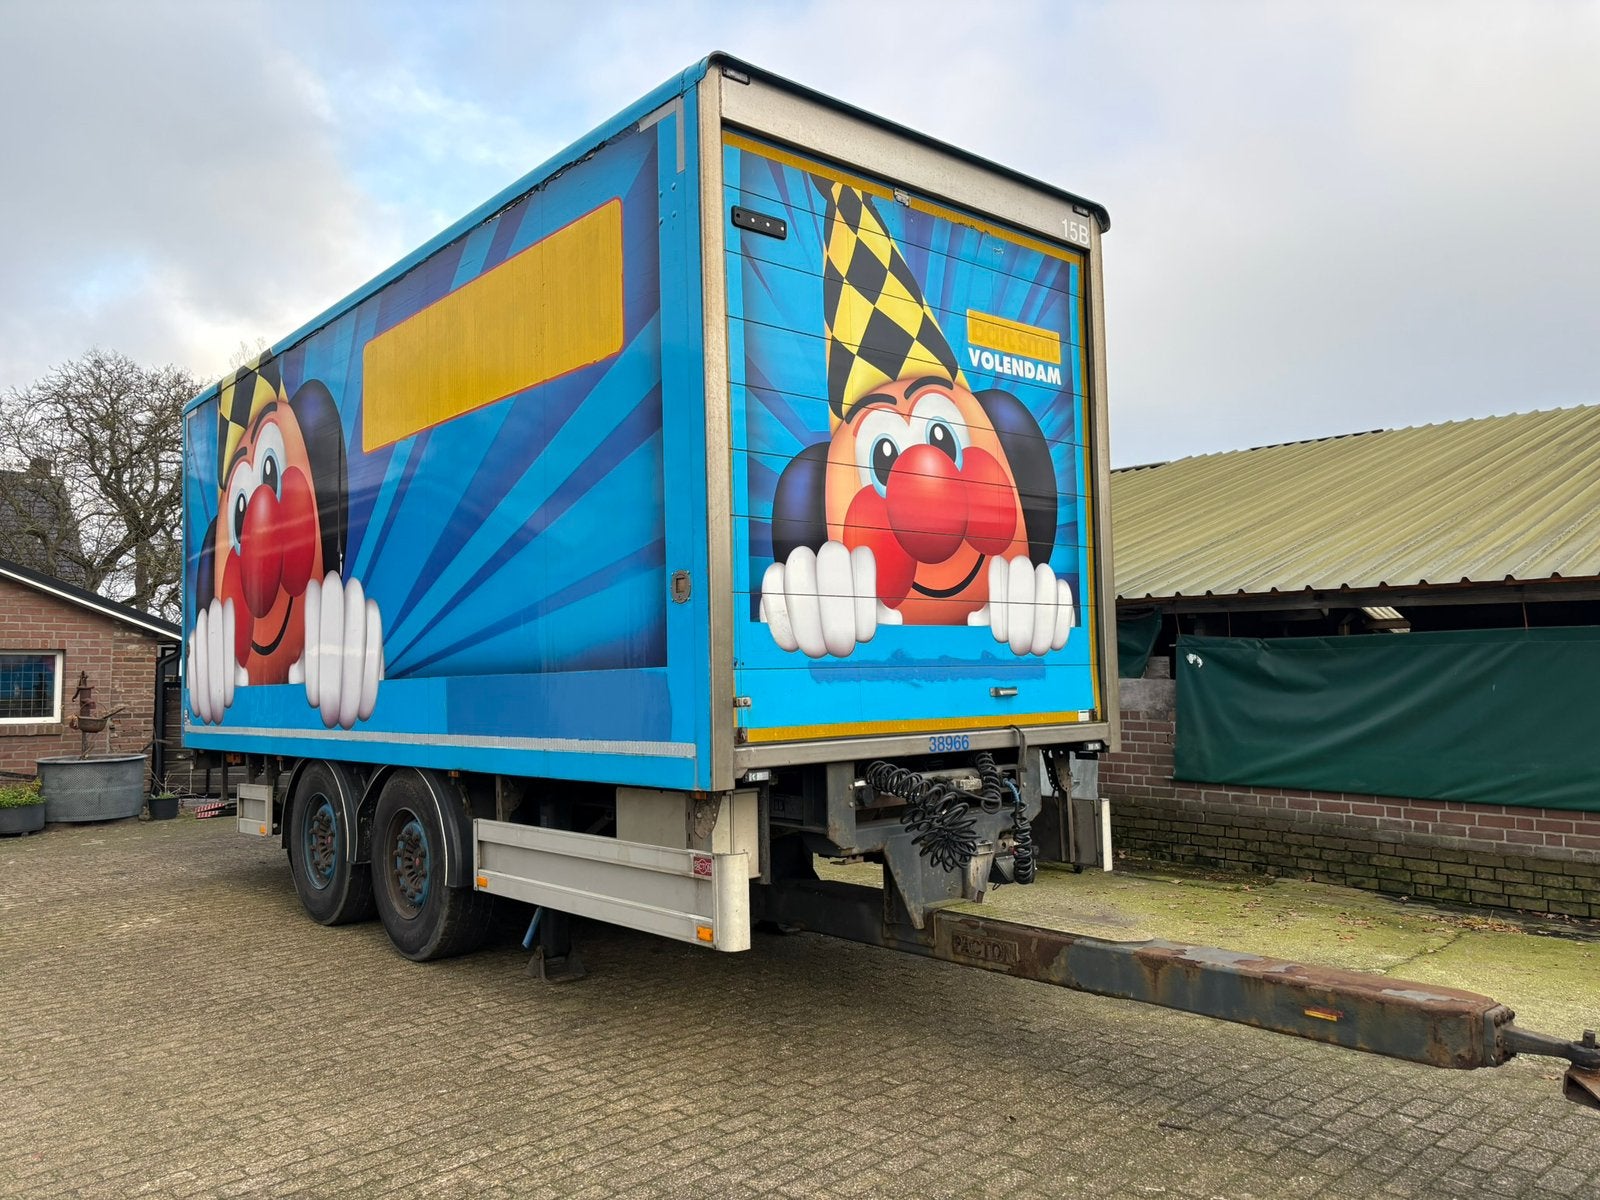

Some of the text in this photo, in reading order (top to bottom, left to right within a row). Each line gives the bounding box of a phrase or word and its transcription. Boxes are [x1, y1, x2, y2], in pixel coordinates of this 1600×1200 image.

[1061, 218, 1089, 245] 15B
[968, 347, 1062, 385] VOLENDAM
[929, 734, 969, 752] 38966
